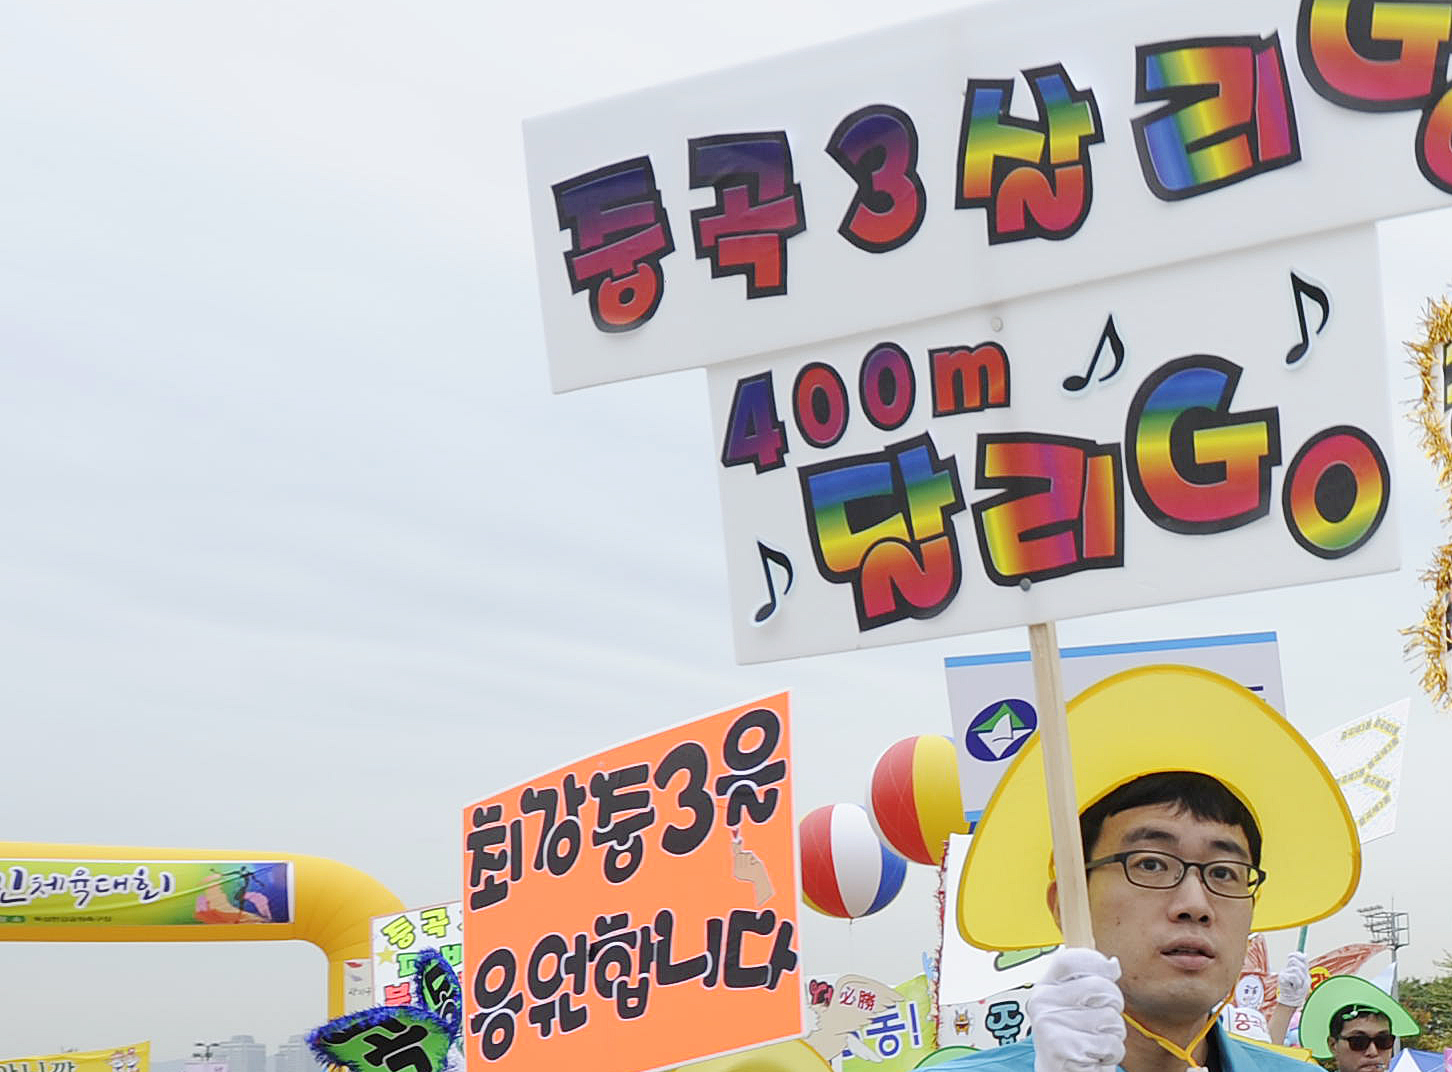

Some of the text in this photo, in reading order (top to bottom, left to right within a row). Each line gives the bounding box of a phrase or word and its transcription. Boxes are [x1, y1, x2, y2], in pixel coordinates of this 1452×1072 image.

[721, 339, 1011, 474] 400m
[380, 906, 462, 950] 중곡
[470, 909, 800, 1062] 응원합니다
